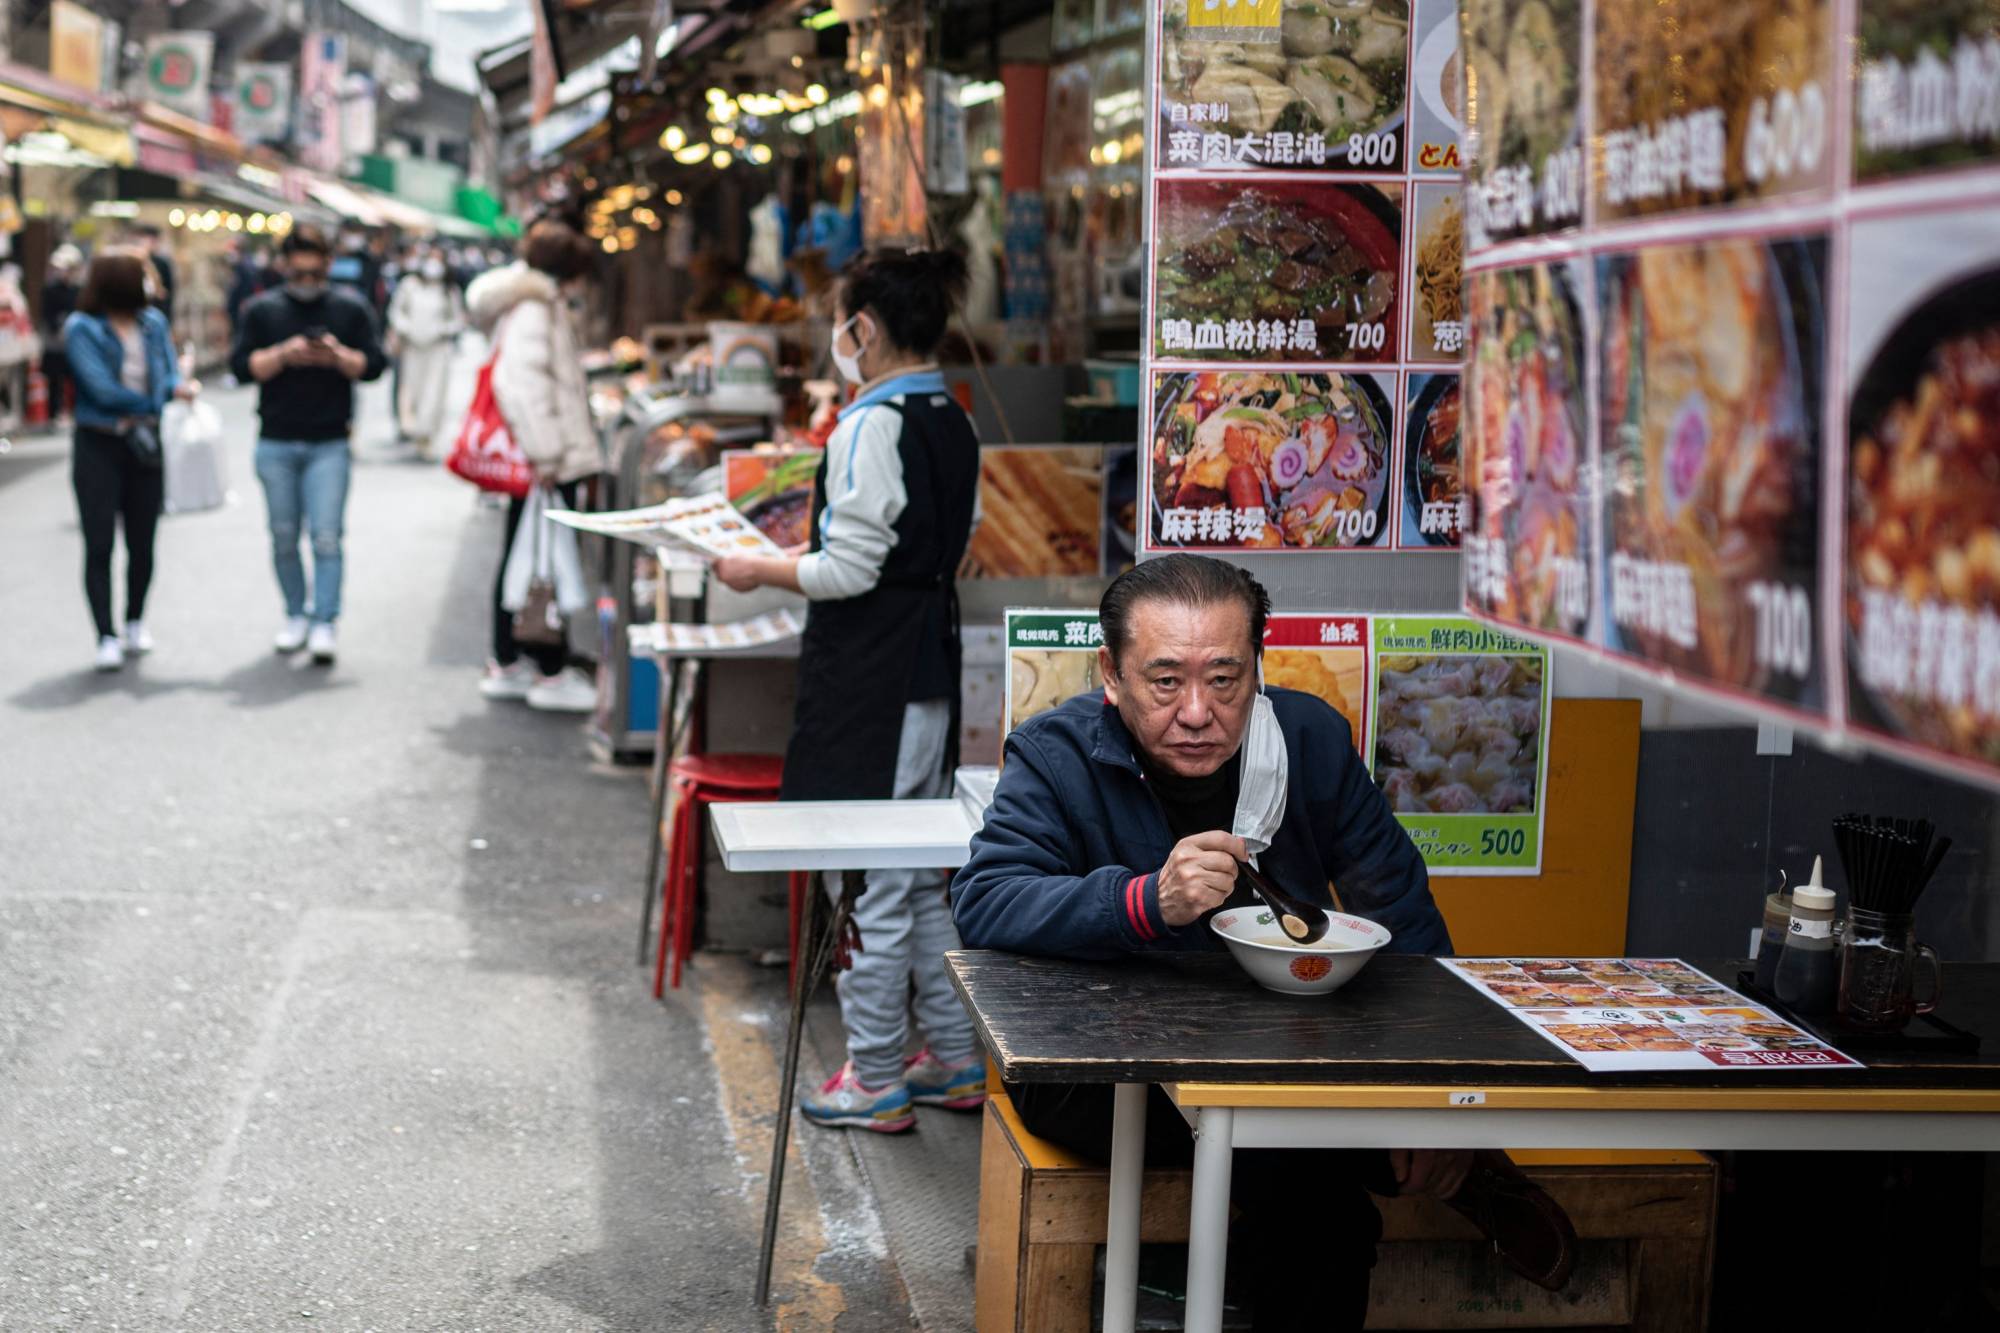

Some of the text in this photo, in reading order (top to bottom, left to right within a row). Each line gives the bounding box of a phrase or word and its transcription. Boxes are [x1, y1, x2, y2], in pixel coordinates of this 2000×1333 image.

[1168, 131, 1397, 165] 菜肉大混沌 800
[1744, 81, 1826, 185] 600
[1162, 318, 1386, 351] 鴨血粉絲湯 700
[1333, 509, 1377, 539] 700
[1320, 622, 1360, 644] 油条
[1746, 579, 1812, 680] 700
[1480, 828, 1526, 856] 500
[1459, 1095, 1476, 1105] 10
